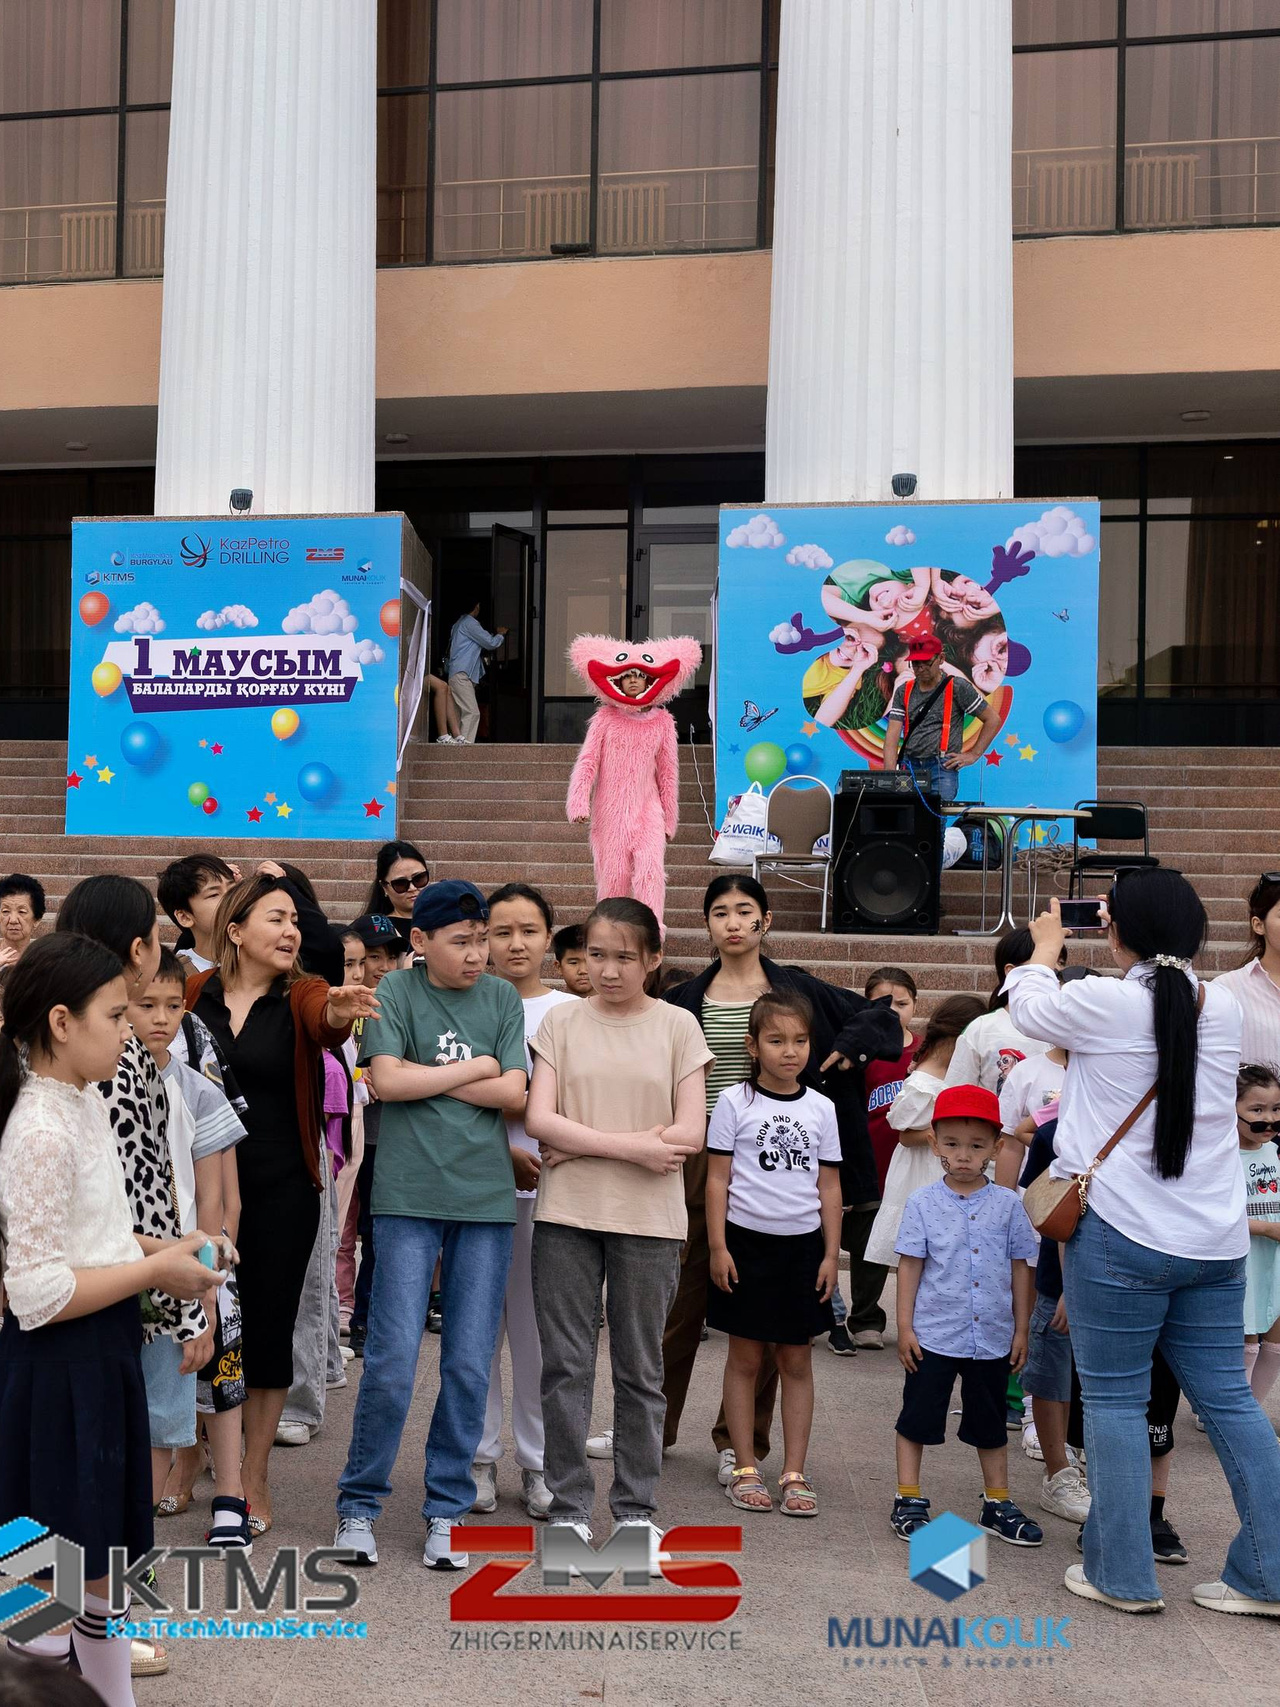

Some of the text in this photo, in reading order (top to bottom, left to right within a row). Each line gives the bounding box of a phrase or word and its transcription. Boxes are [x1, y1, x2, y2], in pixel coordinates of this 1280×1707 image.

[220, 537, 290, 550] KazPetro
[220, 551, 290, 565] DRILLING
[306, 547, 345, 561] ZMS
[130, 558, 173, 566] BURGYLAU
[103, 572, 135, 582] KTMS
[133, 638, 343, 677] 1 МАУСЫМ
[132, 683, 346, 698] БАЛАЛАРДЫ ҚОРҒАУ КҮНІ
[868, 1080, 904, 1111] BORN
[756, 1114, 810, 1150] GROW AND BLOOM
